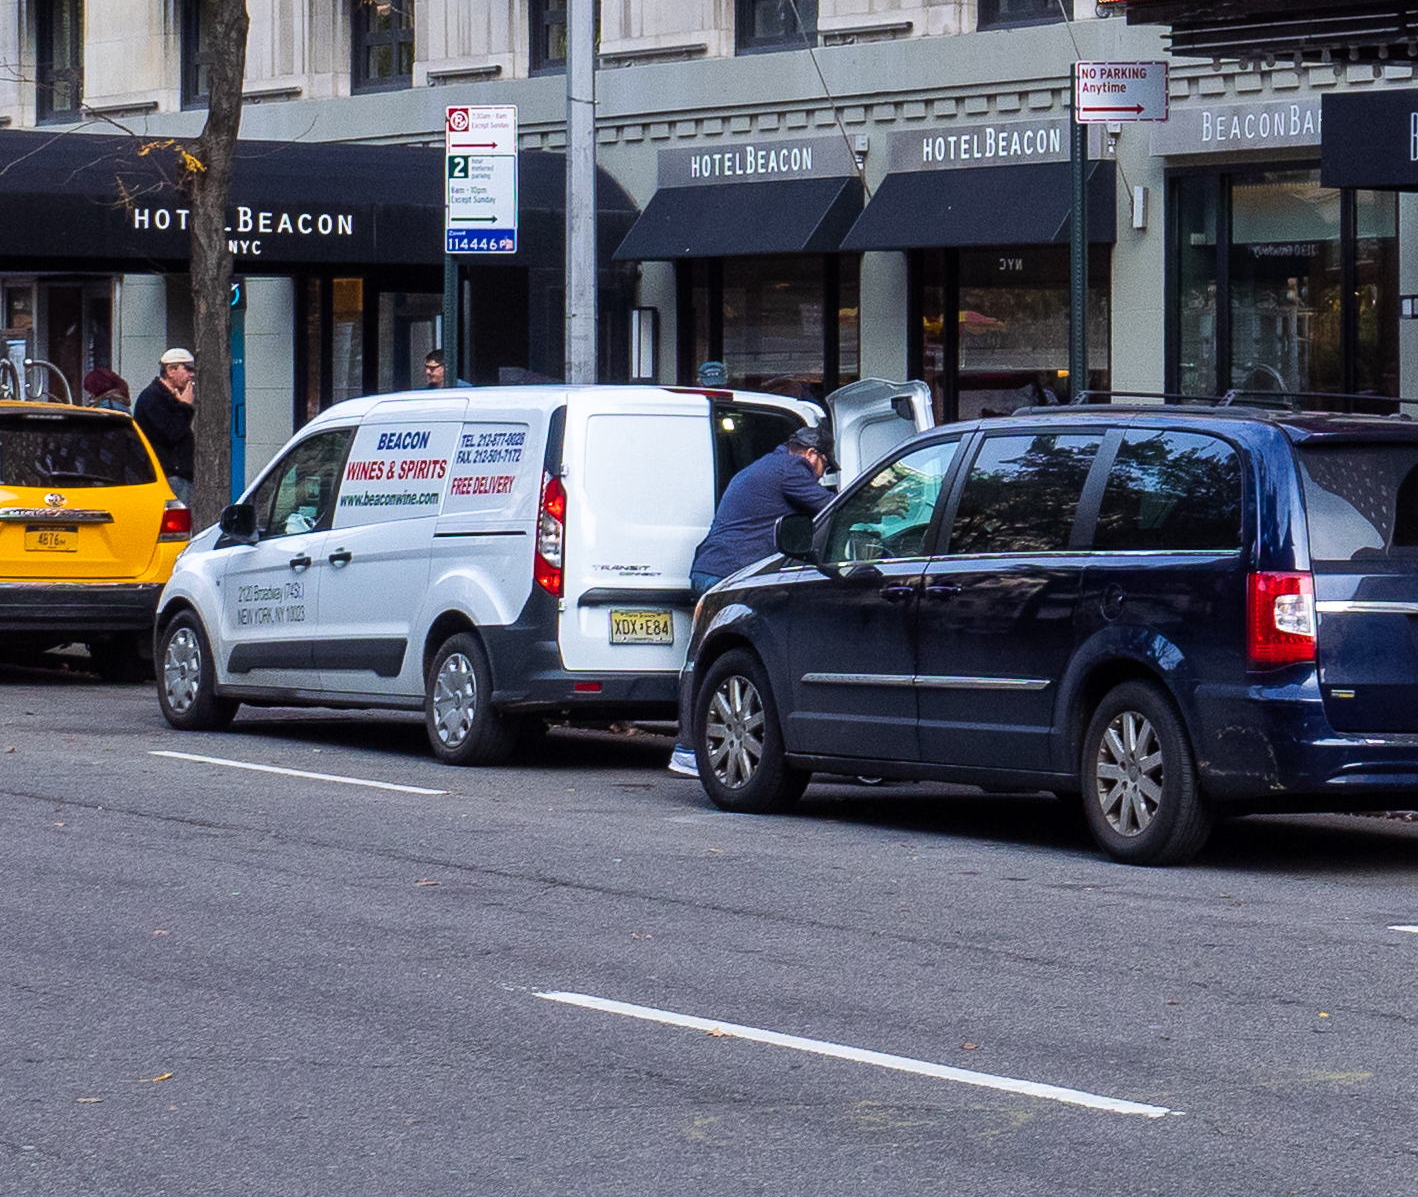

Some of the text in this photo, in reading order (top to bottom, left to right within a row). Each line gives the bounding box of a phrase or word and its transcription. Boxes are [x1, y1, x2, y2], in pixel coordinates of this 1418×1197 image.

[1081, 67, 1148, 79] NO PARKING
[1082, 81, 1127, 97] Anytime
[453, 157, 465, 177] 2
[473, 195, 497, 206] Sunday
[229, 240, 262, 255] NYC
[449, 237, 498, 251] 114446
[377, 431, 432, 451] BEACON
[345, 459, 448, 481] WINES & SPIRITS
[450, 475, 516, 495] FREE DELIVERY
[340, 490, 439, 506] www.beaconwine.com
